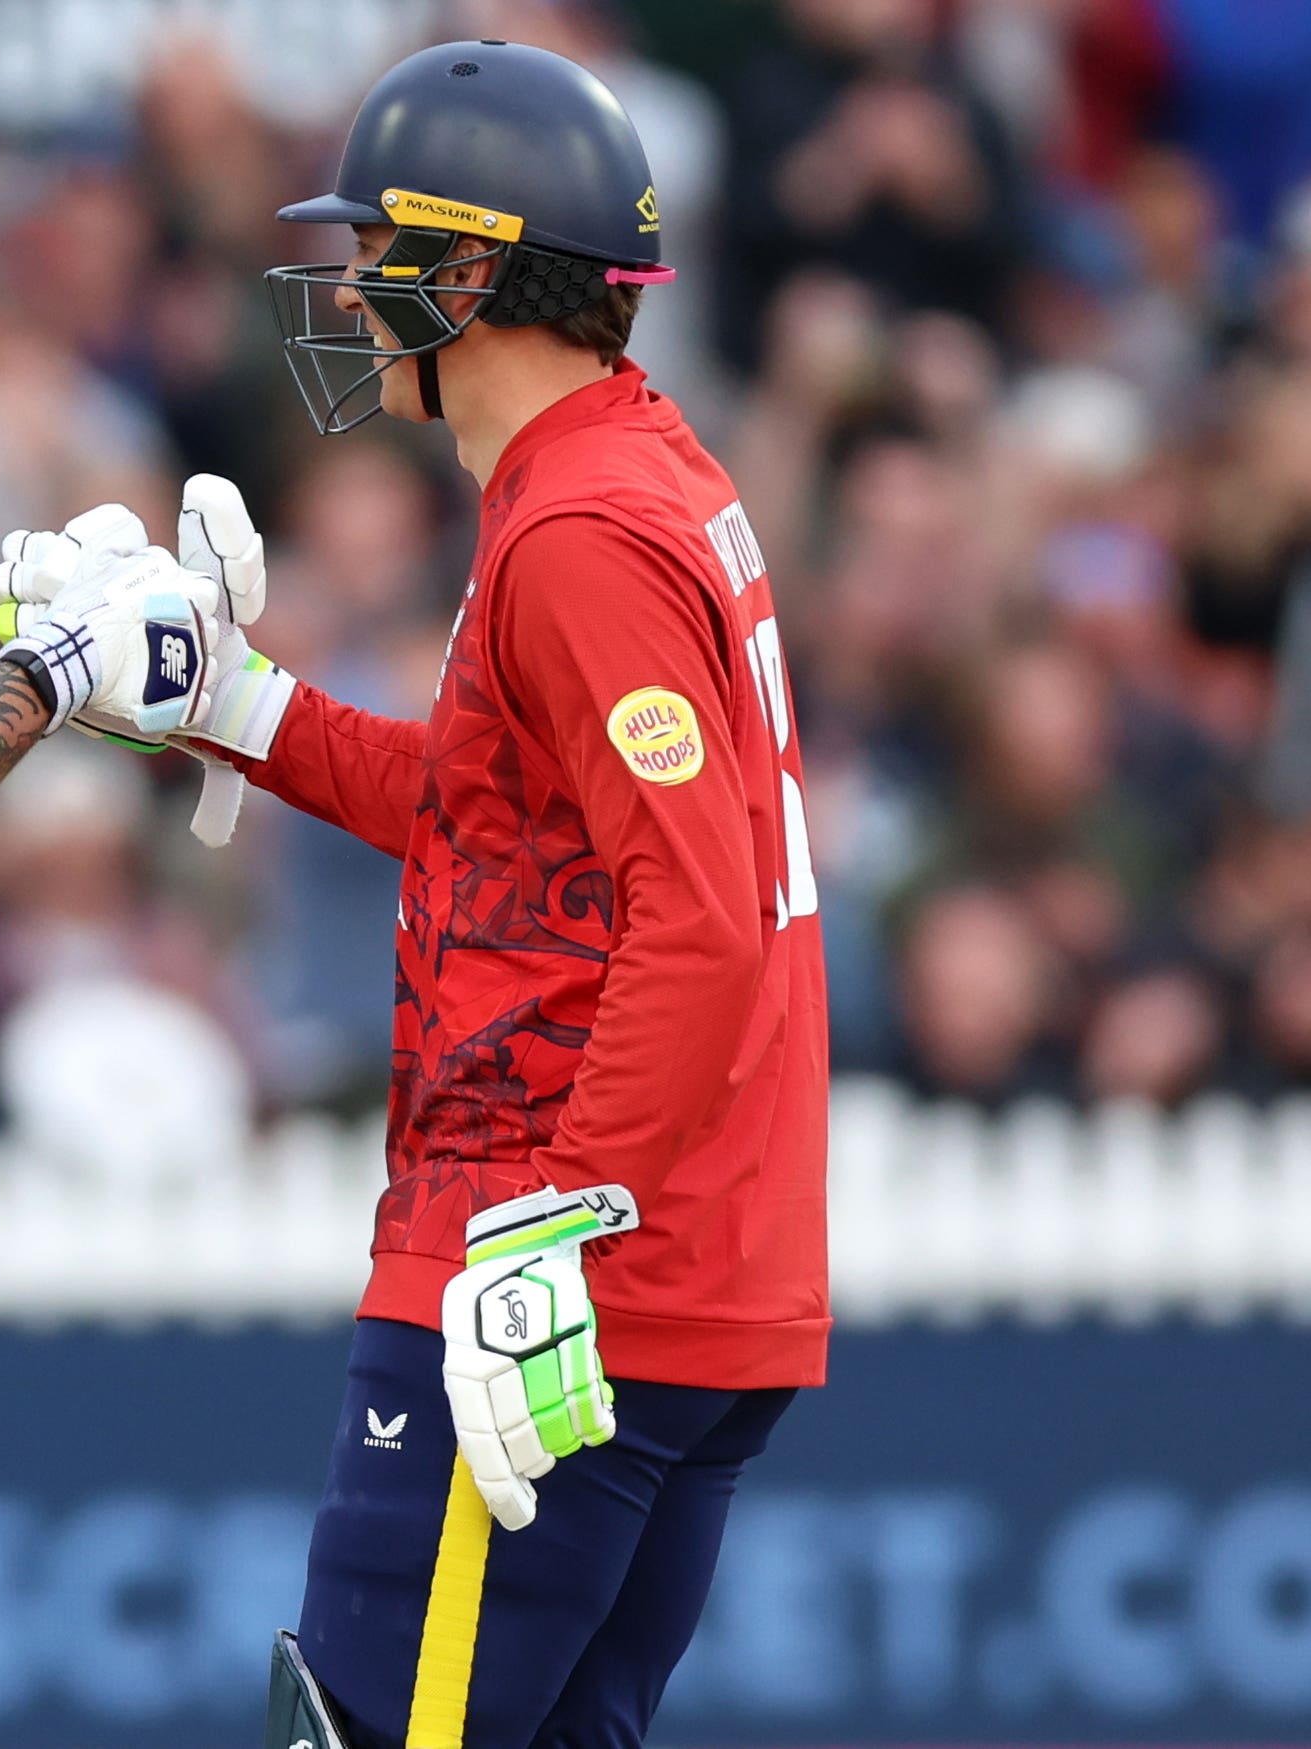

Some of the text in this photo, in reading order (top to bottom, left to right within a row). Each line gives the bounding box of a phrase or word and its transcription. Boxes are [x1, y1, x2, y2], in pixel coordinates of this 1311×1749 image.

[406, 199, 478, 222] MASURI
[625, 705, 681, 740] HULA
[632, 734, 695, 771] HOOPS
